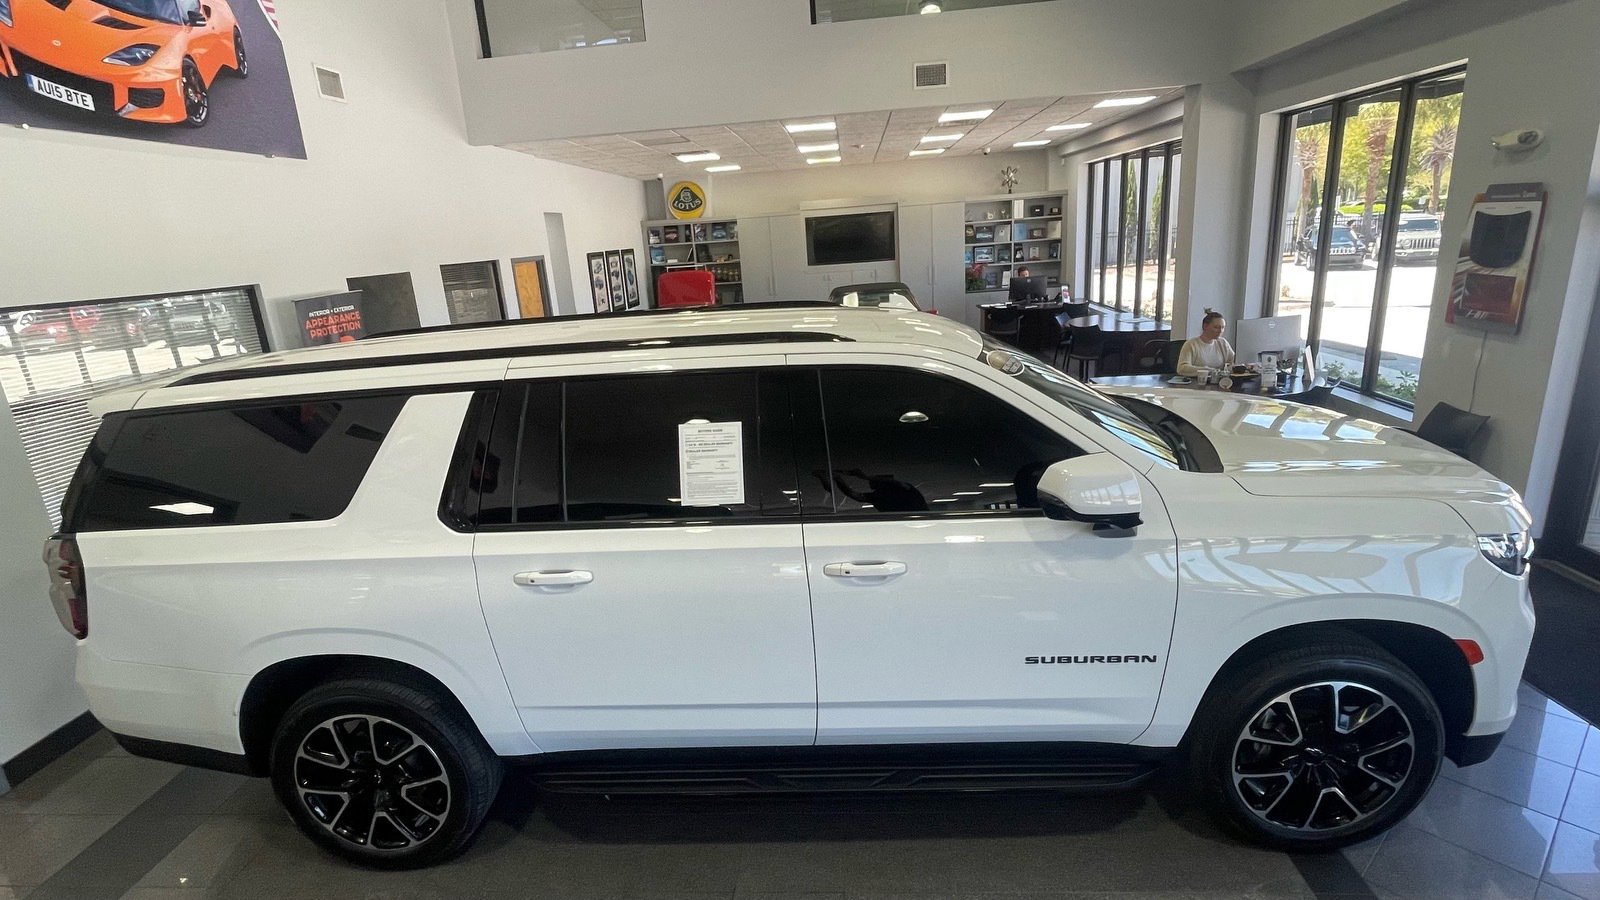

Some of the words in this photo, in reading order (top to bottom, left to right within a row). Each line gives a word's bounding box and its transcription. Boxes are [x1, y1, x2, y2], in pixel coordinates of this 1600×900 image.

[65, 89, 89, 107] BTE
[674, 199, 701, 210] LOTUS
[305, 311, 361, 329] APPEARANCE
[310, 321, 361, 339] PROTECTION
[1024, 655, 1157, 664] SUBURBAN
